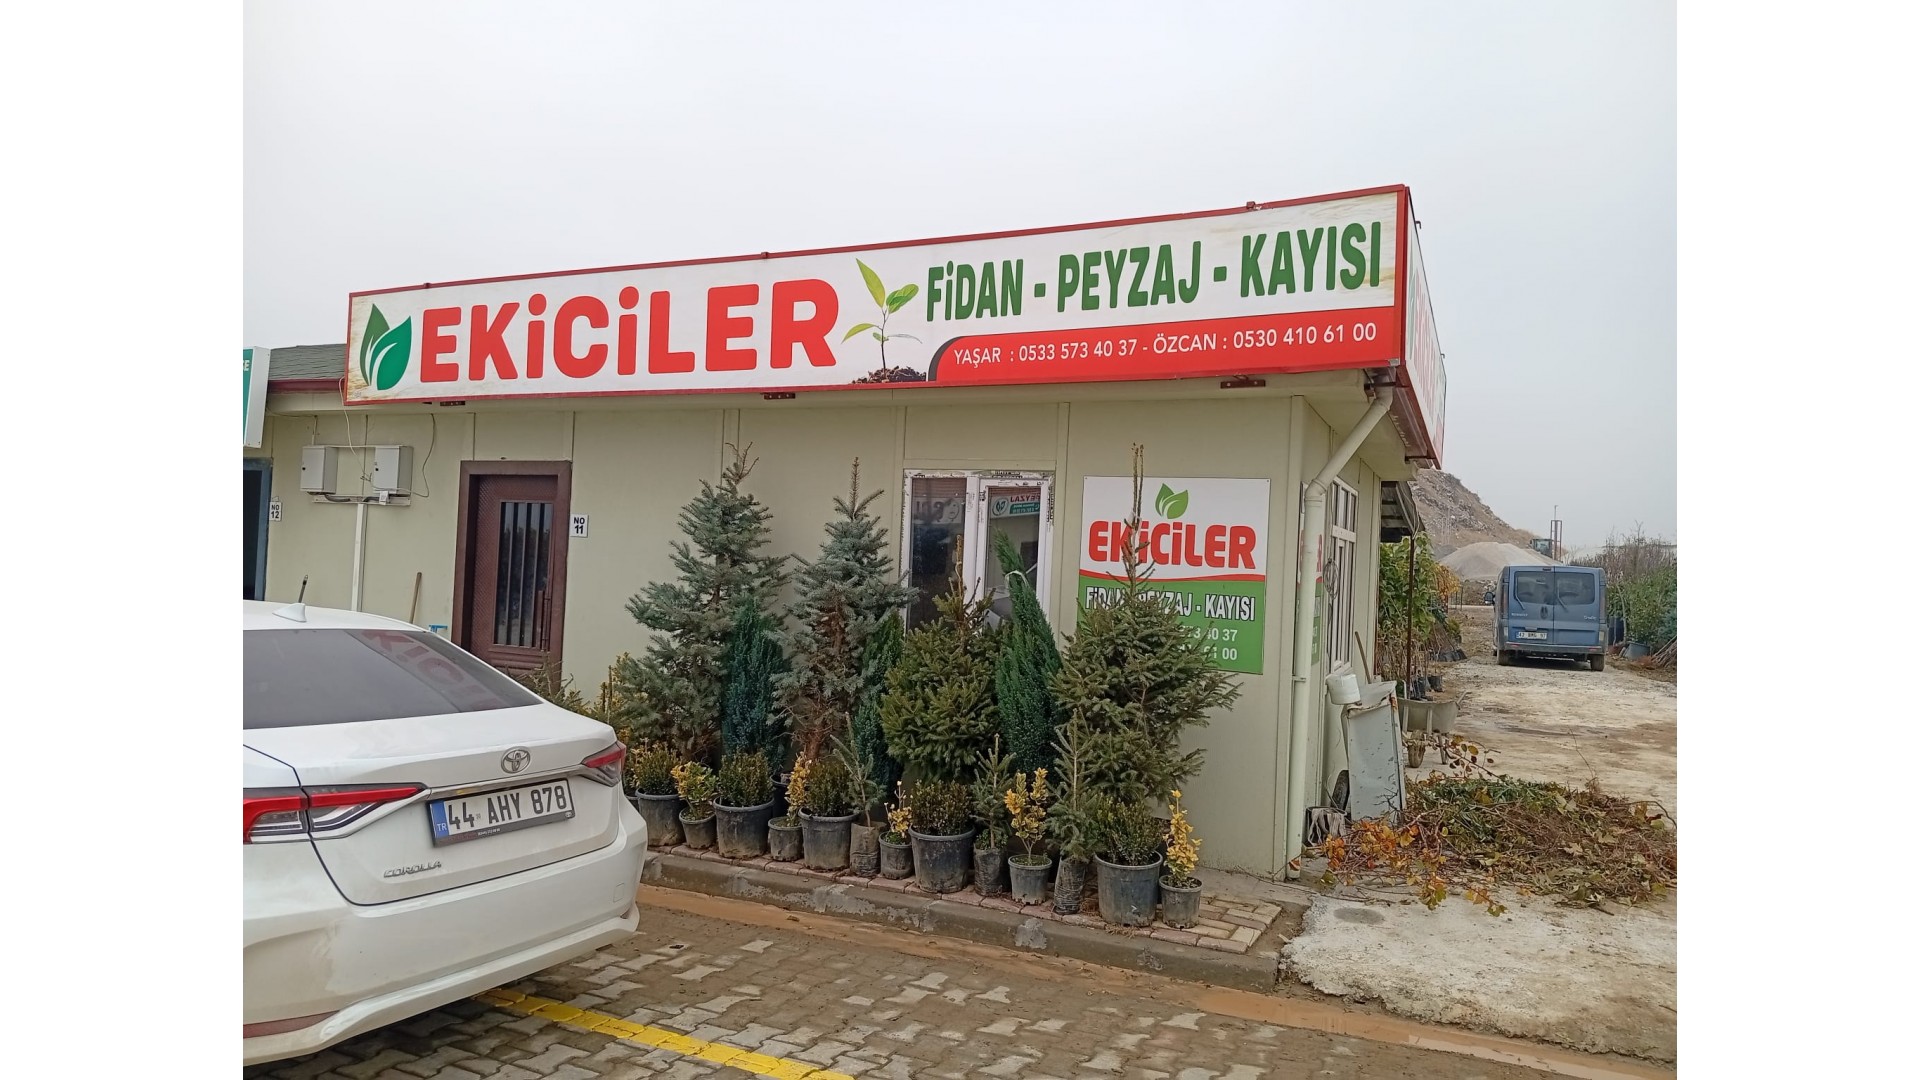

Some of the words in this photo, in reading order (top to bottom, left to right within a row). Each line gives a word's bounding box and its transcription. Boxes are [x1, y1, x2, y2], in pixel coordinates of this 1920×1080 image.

[1057, 241, 1201, 313] PEYZAJ
[1240, 221, 1382, 297] KAYISI
[954, 347, 1001, 368] YAŞAR
[1019, 344, 1055, 361] 0533
[1060, 342, 1089, 359] 573
[1093, 340, 1113, 357] 40
[1118, 338, 1137, 356] 37
[1153, 333, 1217, 354] ÖZCAN
[1233, 328, 1277, 349] 0530
[1283, 326, 1317, 345] 410
[1323, 324, 1344, 343] 61
[1353, 322, 1377, 342] 00
[270, 510, 280, 519] 12
[574, 516, 585, 525] NO
[574, 525, 584, 534] 11
[1205, 594, 1255, 621] KAYISI
[1222, 628, 1238, 641] 37
[1222, 647, 1238, 660] 00
[448, 801, 475, 830] 44
[487, 792, 522, 824] AHY
[531, 785, 567, 815] 878
[436, 823, 448, 832] TR
